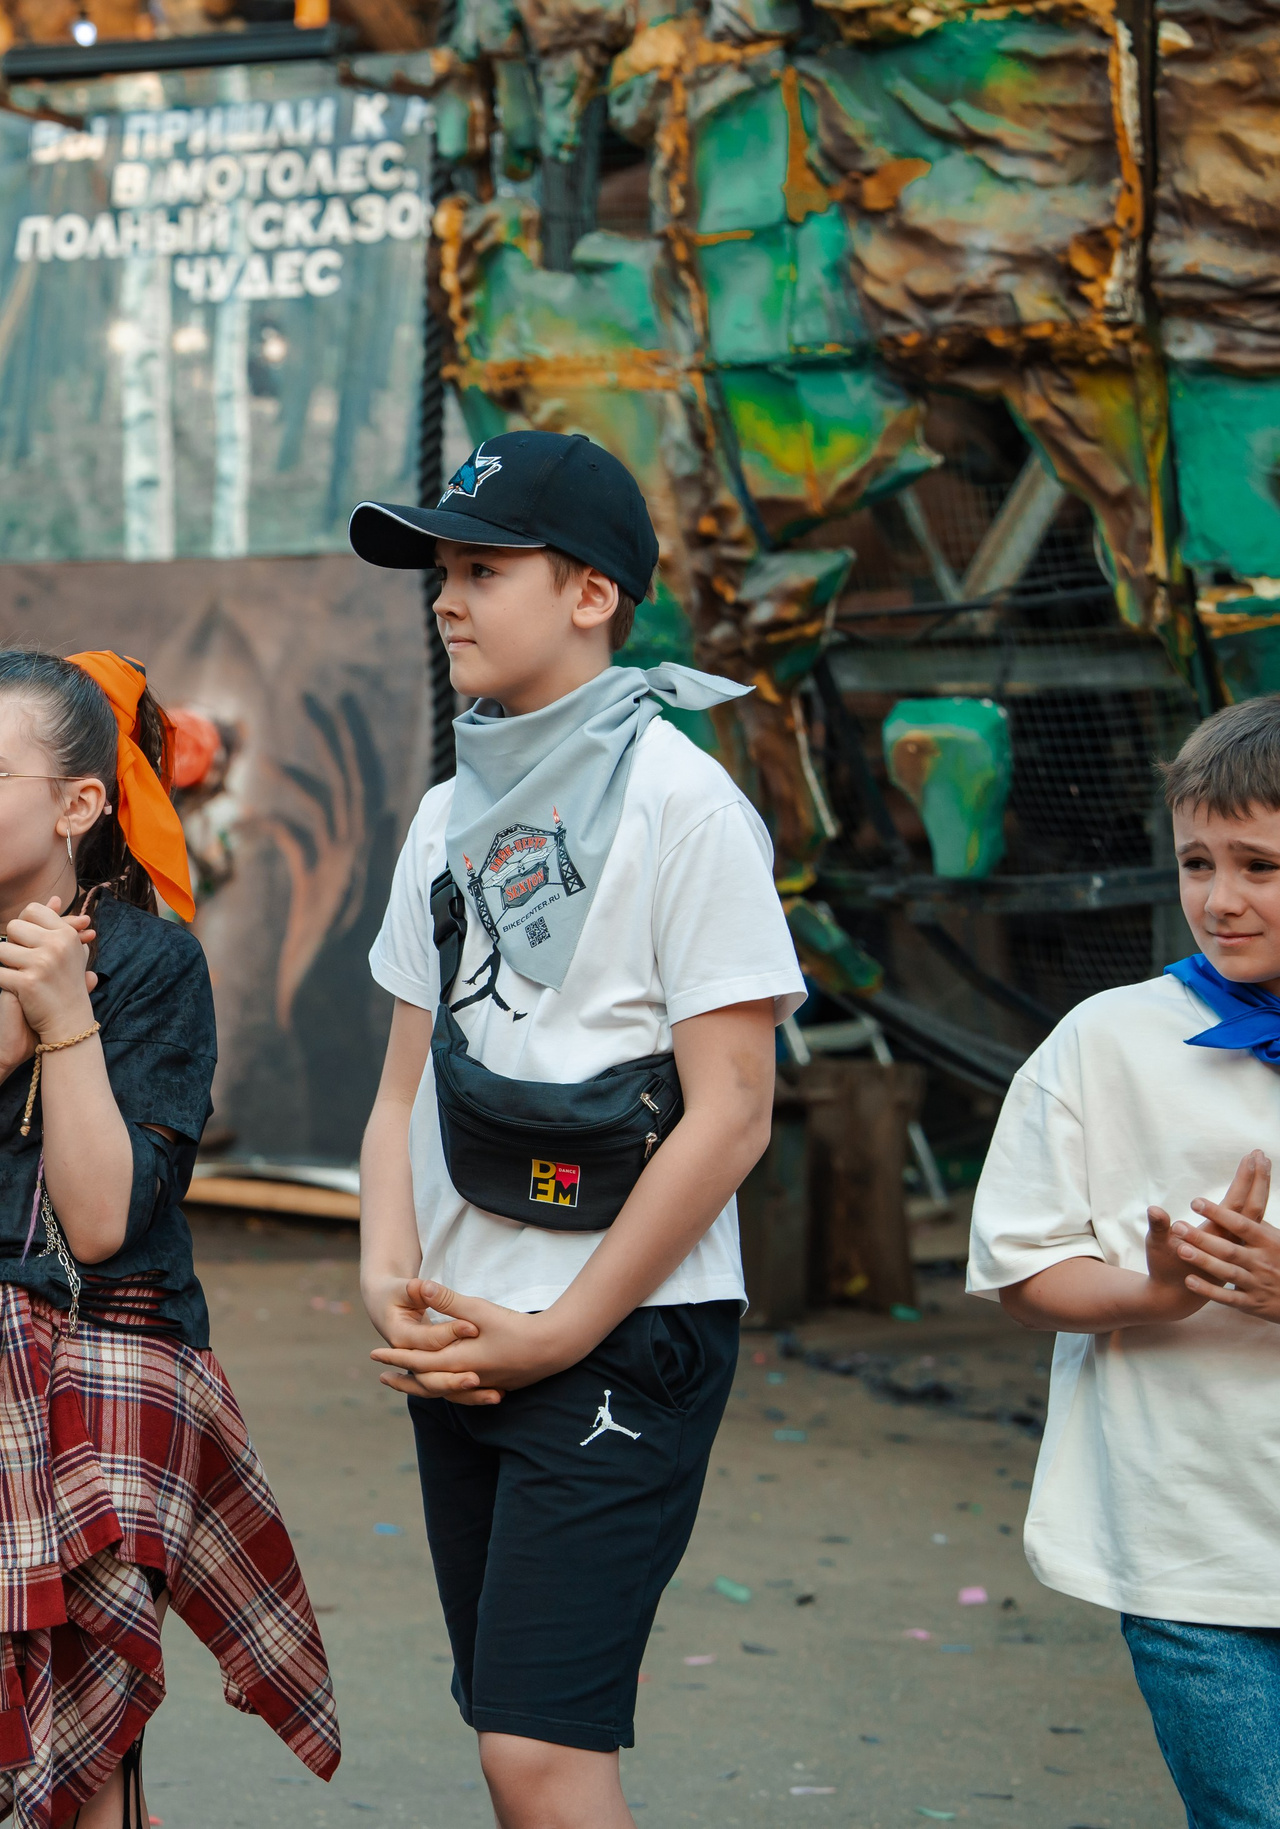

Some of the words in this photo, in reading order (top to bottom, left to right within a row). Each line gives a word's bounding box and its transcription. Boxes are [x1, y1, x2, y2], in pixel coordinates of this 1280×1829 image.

[123, 97, 337, 160] ПРИШЛИ
[351, 93, 389, 140] К
[111, 162, 150, 208] В
[15, 203, 228, 262] ПОЛНЫЙ
[174, 247, 343, 302] ЧУДЕС
[505, 867, 545, 902] SEXTON
[502, 892, 561, 933] BIKECENTER.RU
